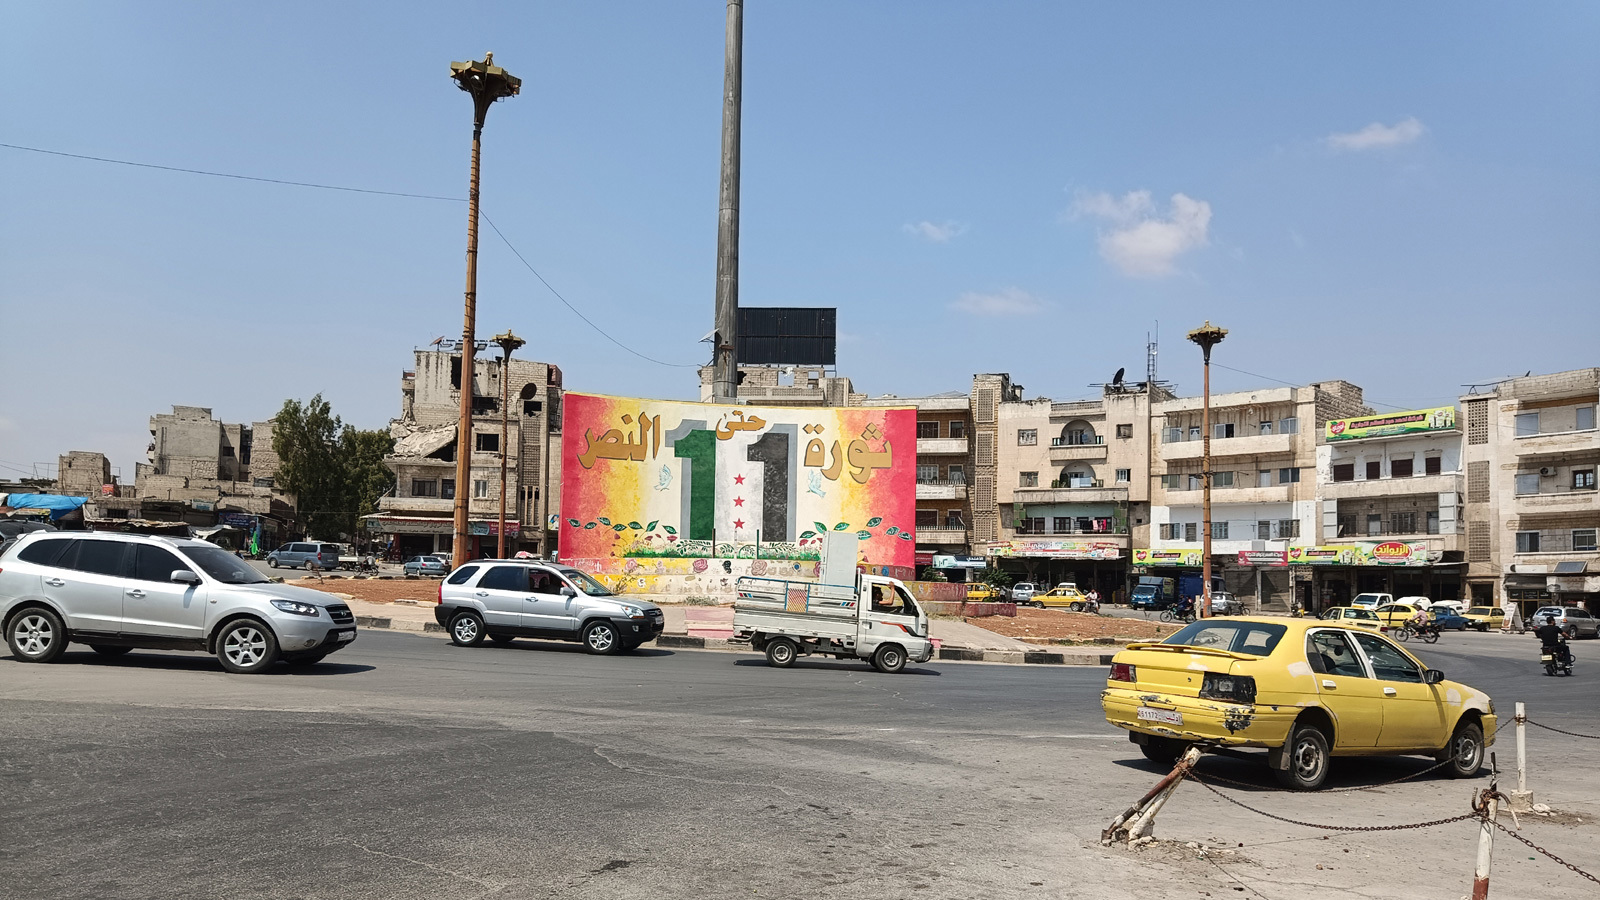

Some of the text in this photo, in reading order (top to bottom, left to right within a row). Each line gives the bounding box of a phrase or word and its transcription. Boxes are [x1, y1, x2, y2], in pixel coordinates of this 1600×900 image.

[577, 411, 660, 469] النصر
[803, 422, 893, 484] ثورة
[665, 419, 798, 542] 11
